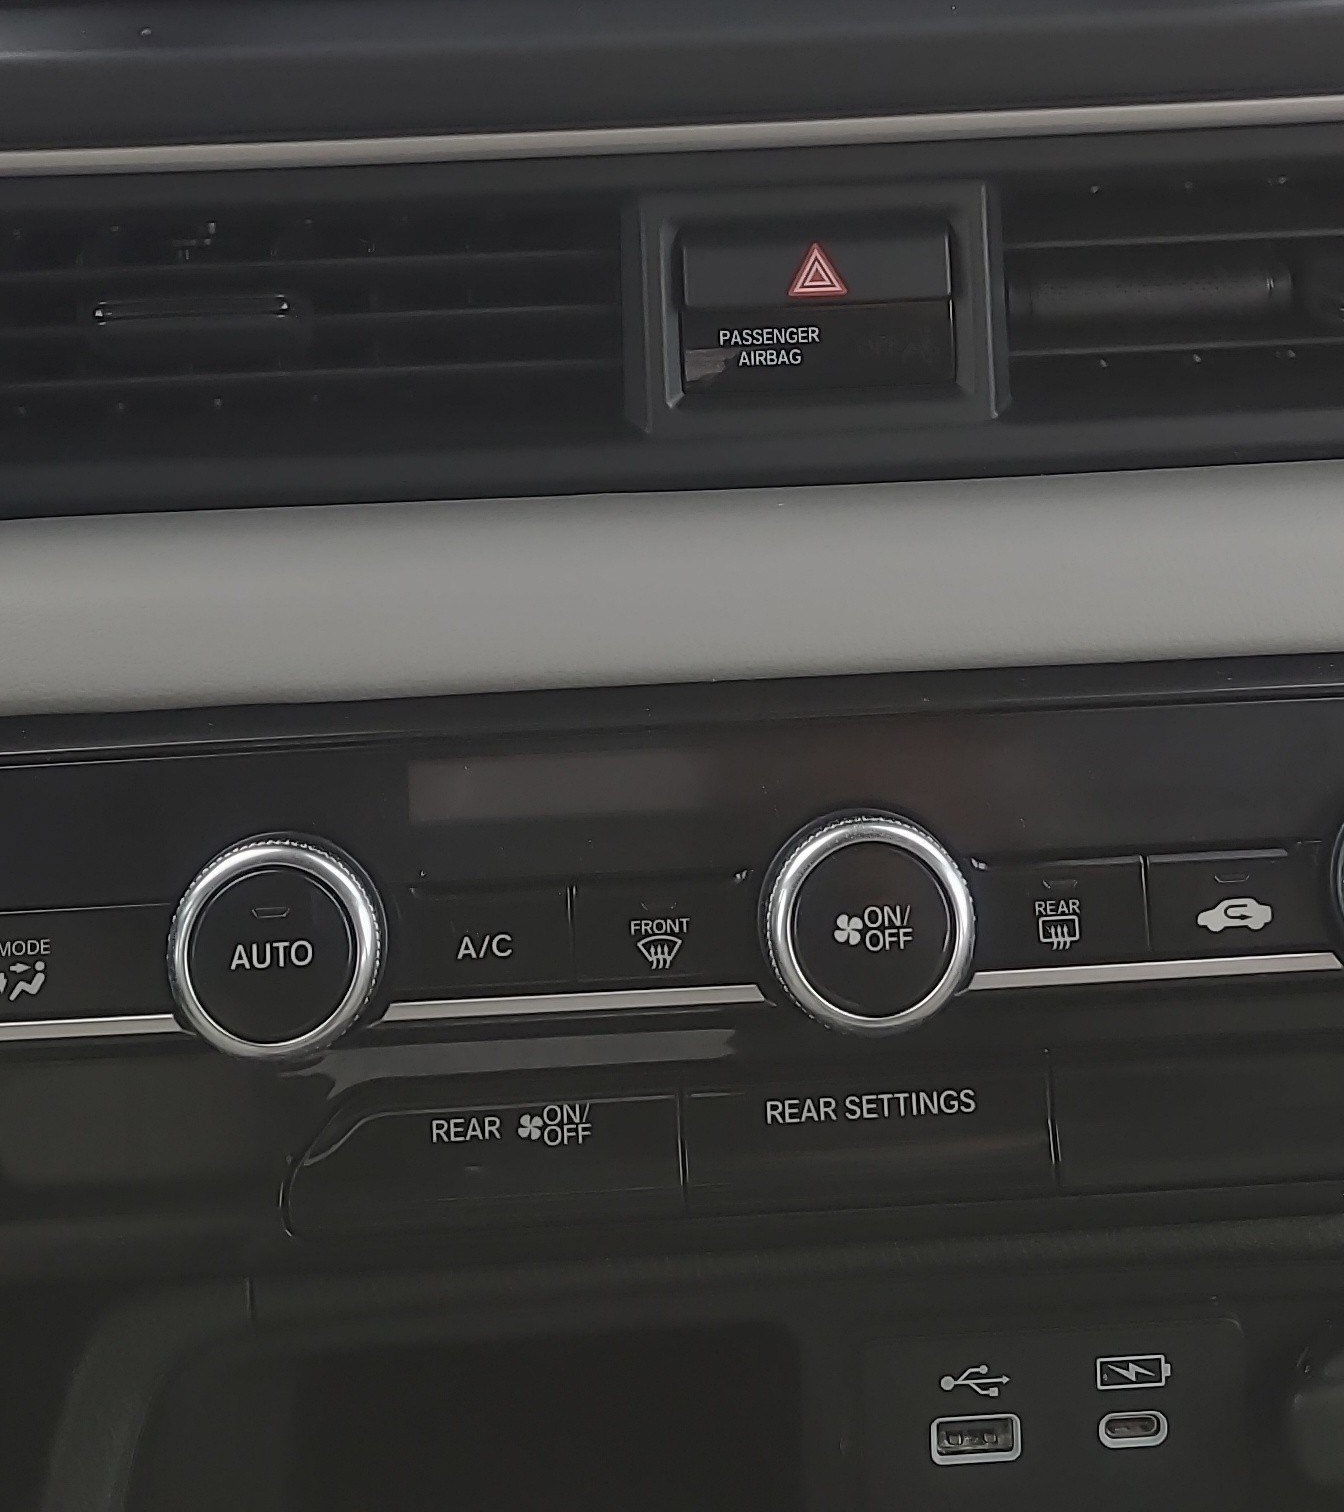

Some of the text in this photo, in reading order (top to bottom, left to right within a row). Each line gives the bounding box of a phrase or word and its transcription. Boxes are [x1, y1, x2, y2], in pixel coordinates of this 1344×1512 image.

[719, 326, 820, 346] PASSENGER
[738, 348, 802, 366] AIRBAG
[863, 904, 912, 928] ON/
[1034, 899, 1081, 917] REAR
[630, 917, 690, 936] FRONT
[457, 934, 513, 960] A/C
[864, 928, 913, 952] OFF
[230, 940, 313, 970] AUTO
[542, 1102, 591, 1125] ON/
[766, 1089, 976, 1125] REAR SETTINGS
[431, 1116, 501, 1143] REAR
[543, 1123, 592, 1146] OFF
